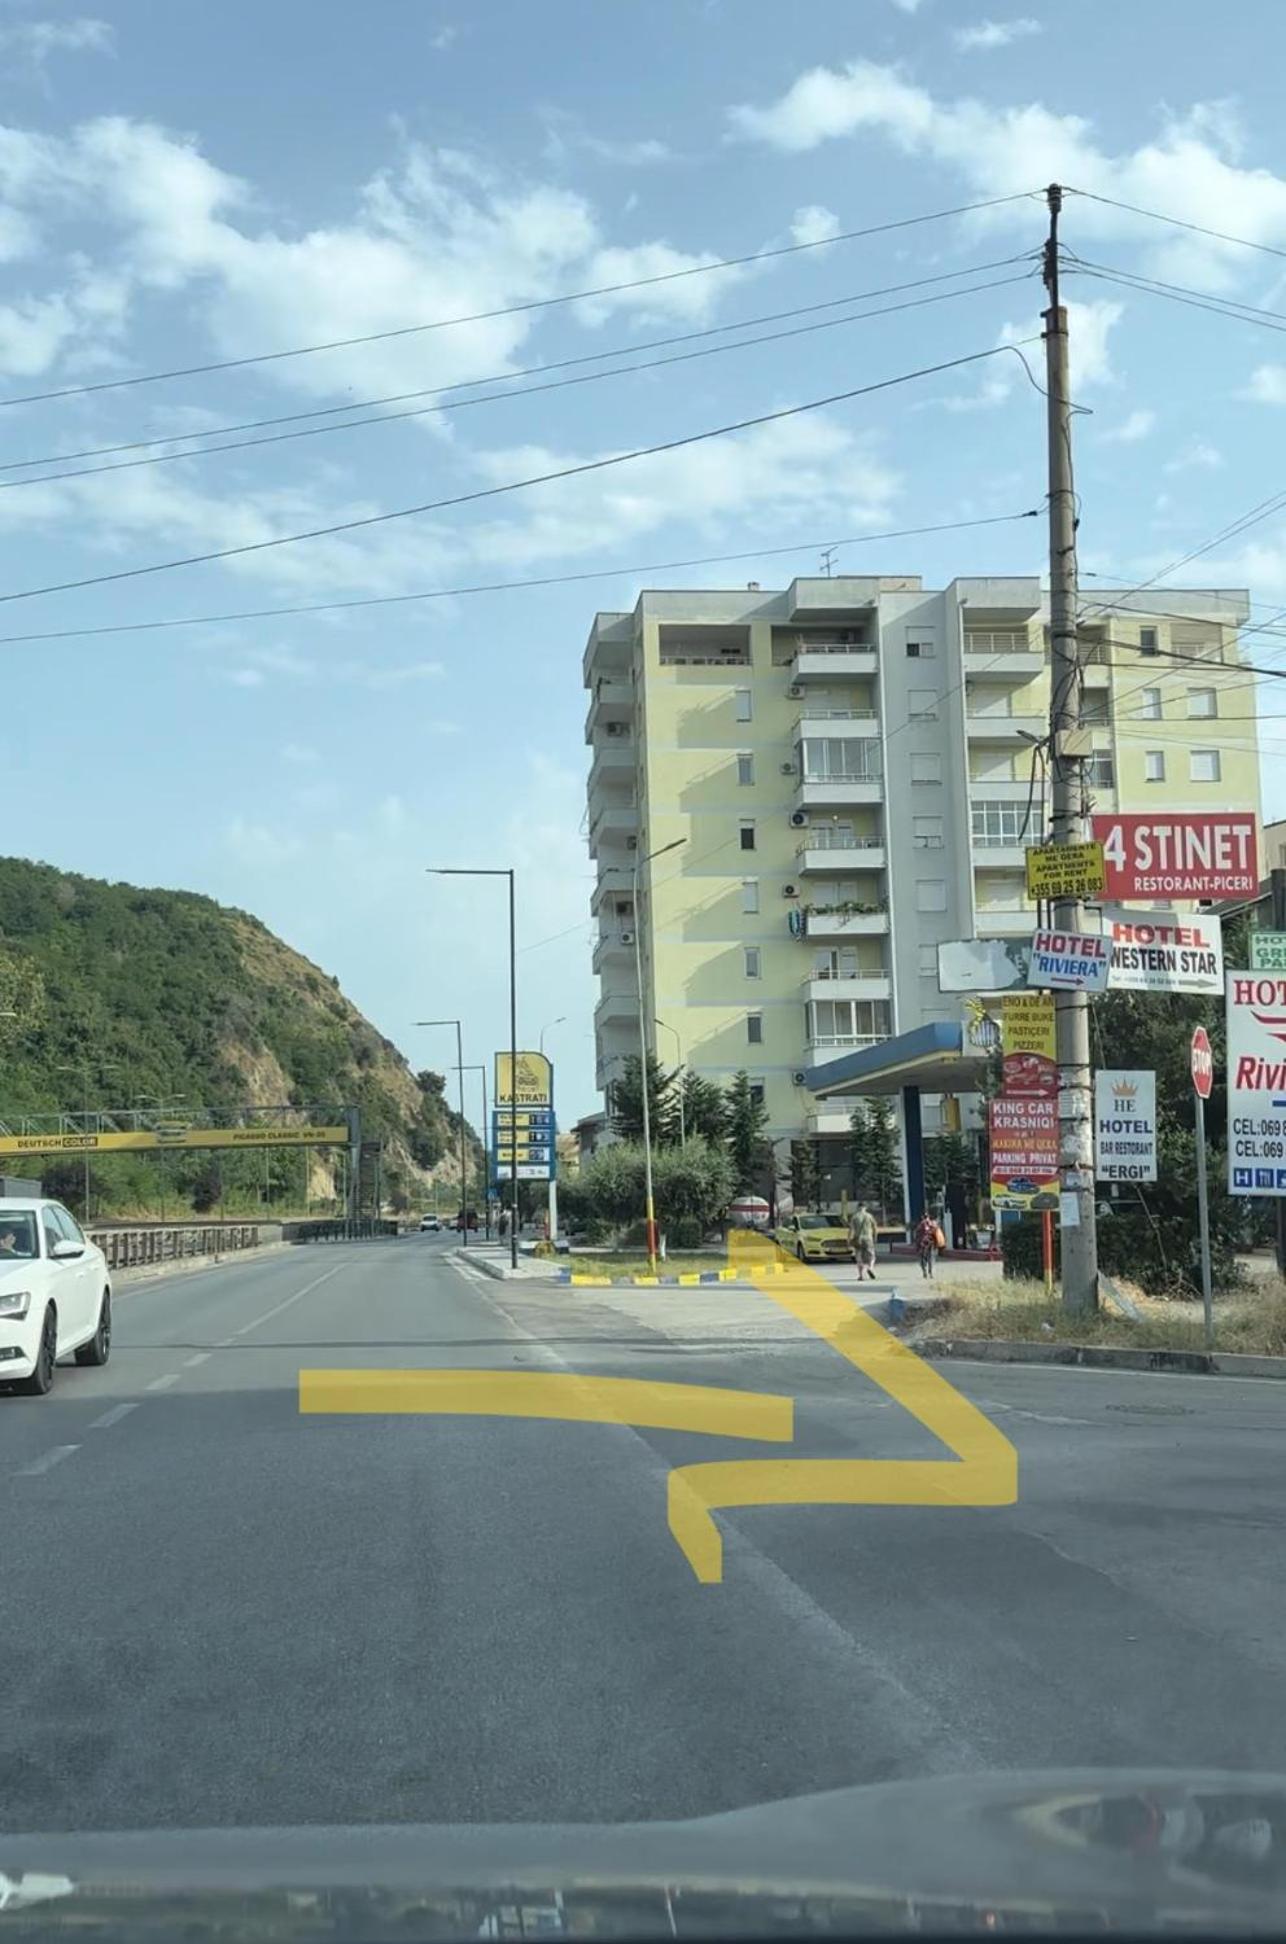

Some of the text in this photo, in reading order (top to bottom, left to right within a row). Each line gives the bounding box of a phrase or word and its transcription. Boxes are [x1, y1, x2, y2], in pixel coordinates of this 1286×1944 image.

[1103, 825, 1251, 872] 4 STINET
[1036, 860, 1095, 872] APARTMENTS
[1064, 868, 1087, 877] RENT
[1134, 876, 1253, 891] RESTORANT-PICERI
[1112, 923, 1210, 948] HOTEL
[1255, 936, 1286, 944] HO
[1036, 932, 1106, 958] HOTEL
[1033, 953, 1107, 977] "RIVIERA"
[1181, 951, 1217, 975] STAR
[500, 1093, 548, 1103] KASTRATI
[994, 1103, 1053, 1114] KING CAR
[1114, 1099, 1136, 1112] HE
[994, 1117, 1055, 1128] KRASNIQI
[1100, 1120, 1153, 1133] HOTEL
[18, 1139, 61, 1148] DEUTSCH
[993, 1152, 1057, 1164] PARKING PRIVAT
